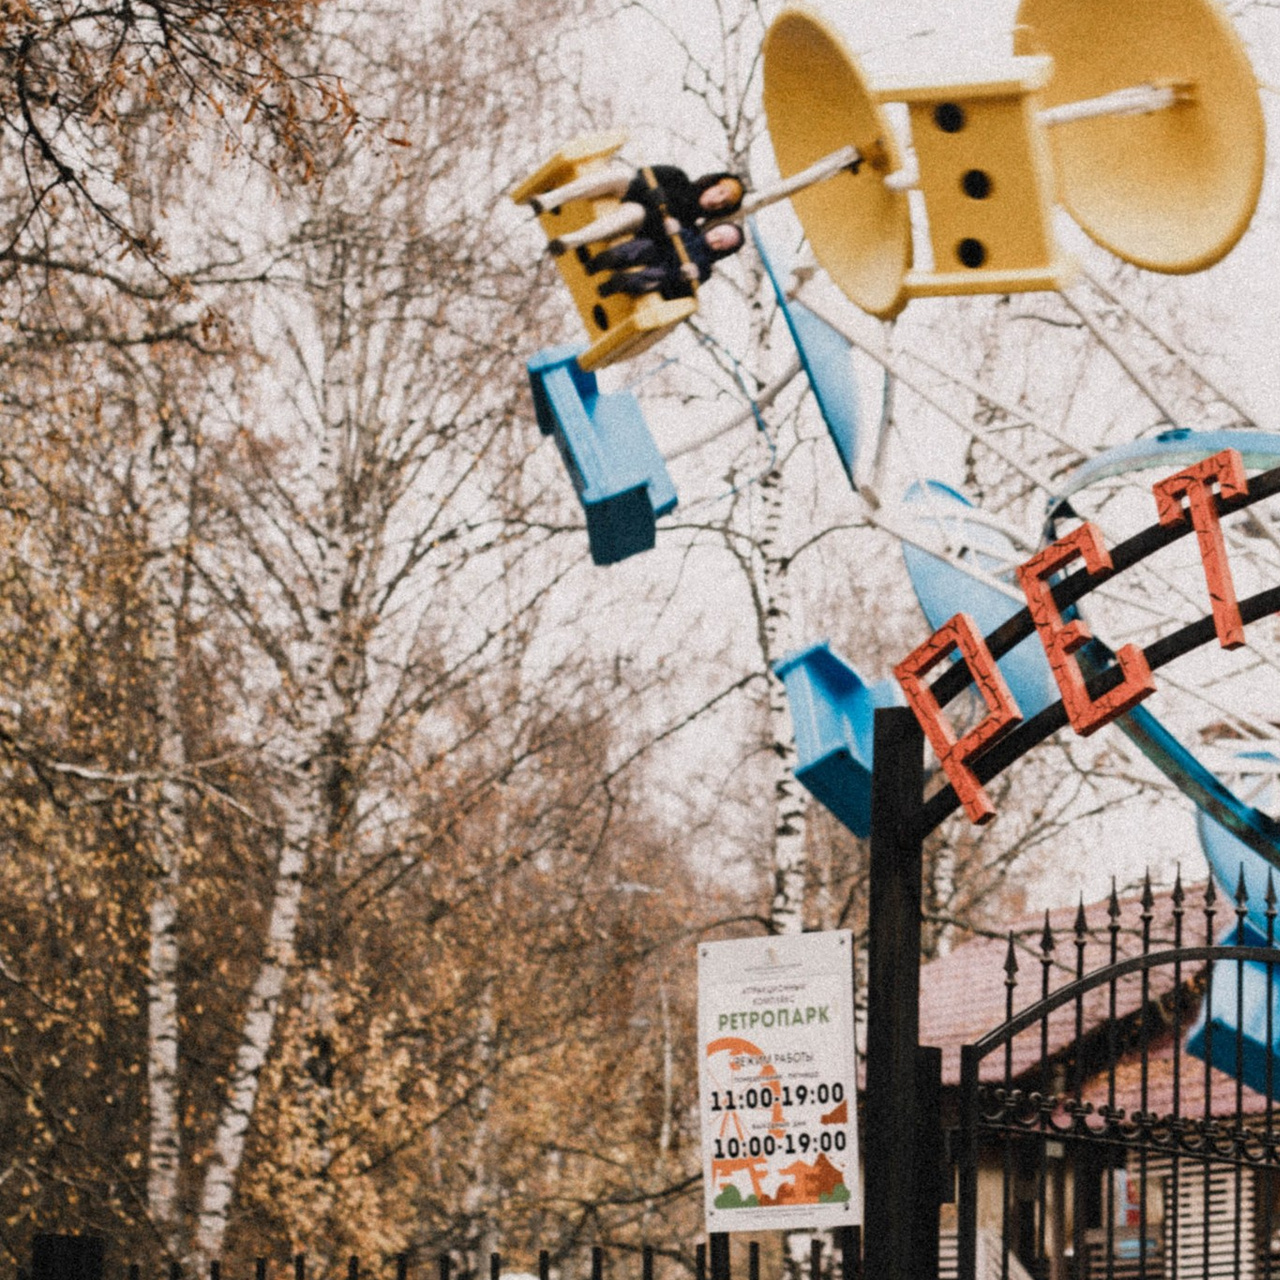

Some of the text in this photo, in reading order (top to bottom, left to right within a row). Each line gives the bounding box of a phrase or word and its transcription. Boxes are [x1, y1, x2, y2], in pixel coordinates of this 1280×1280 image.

[718, 1005, 830, 1031] РЕТРОПАРК
[774, 1051, 814, 1064] РАБОТЫ
[711, 1082, 844, 1111] 11:00-19:00
[714, 1131, 847, 1159] 10:00-19:00
